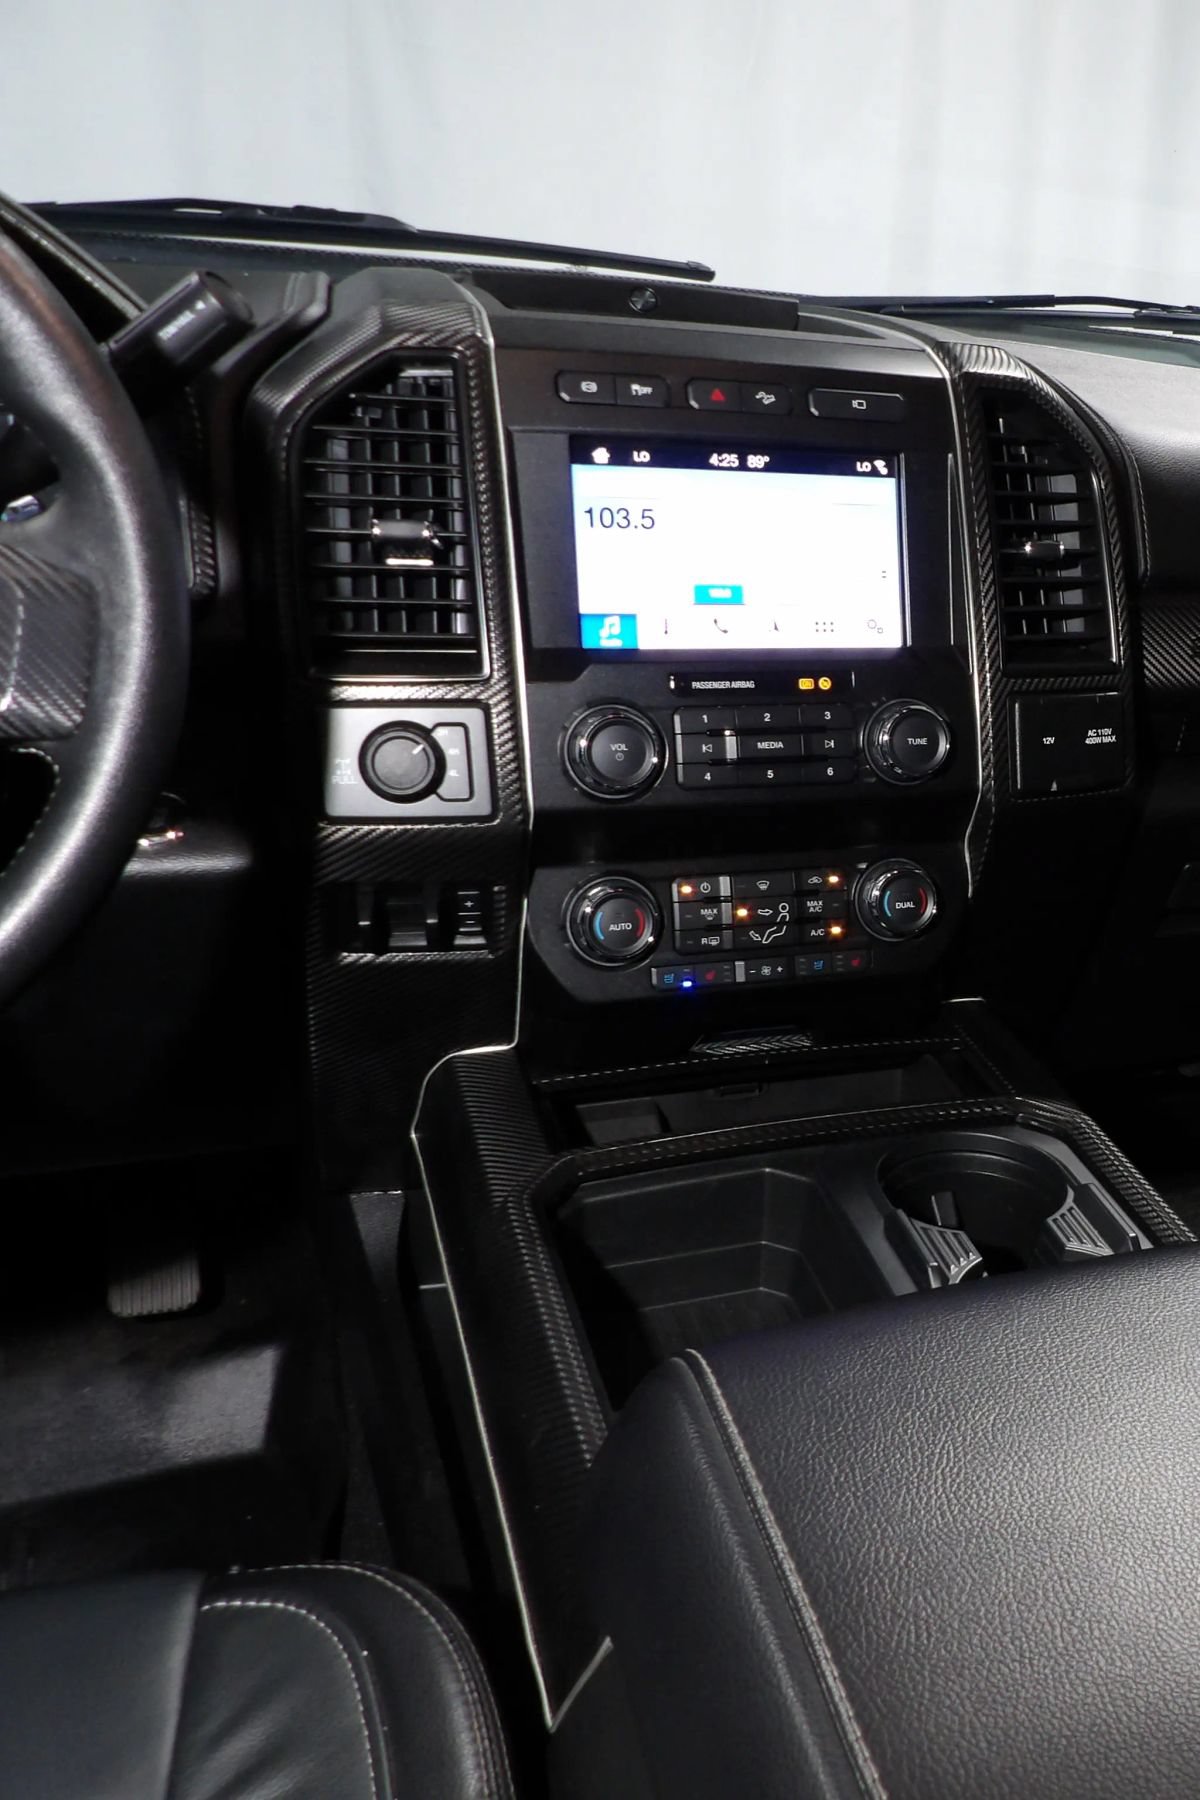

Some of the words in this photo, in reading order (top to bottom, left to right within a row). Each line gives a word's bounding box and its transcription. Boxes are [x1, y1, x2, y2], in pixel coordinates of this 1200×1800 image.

[632, 450, 651, 463] LO
[708, 452, 740, 468] 4:25
[746, 454, 770, 469] 89°
[856, 461, 872, 472] LO
[584, 507, 655, 530] 103.5
[691, 681, 731, 689] PASSENGER
[731, 680, 755, 689] AIRBAG
[702, 714, 708, 723] 1
[763, 712, 771, 722] 2
[824, 711, 831, 720] 3
[1087, 729, 1097, 737] AC
[907, 737, 928, 745] TUNE
[1042, 737, 1055, 745] 12V
[1102, 735, 1117, 743] MAX
[609, 743, 628, 751] VOL
[757, 741, 784, 750] MEDIA
[767, 770, 774, 779] 5
[827, 767, 834, 776] 6
[704, 772, 711, 781] 4
[895, 901, 916, 909] DUAL
[609, 922, 632, 931] AUTO
[701, 937, 708, 945] R
